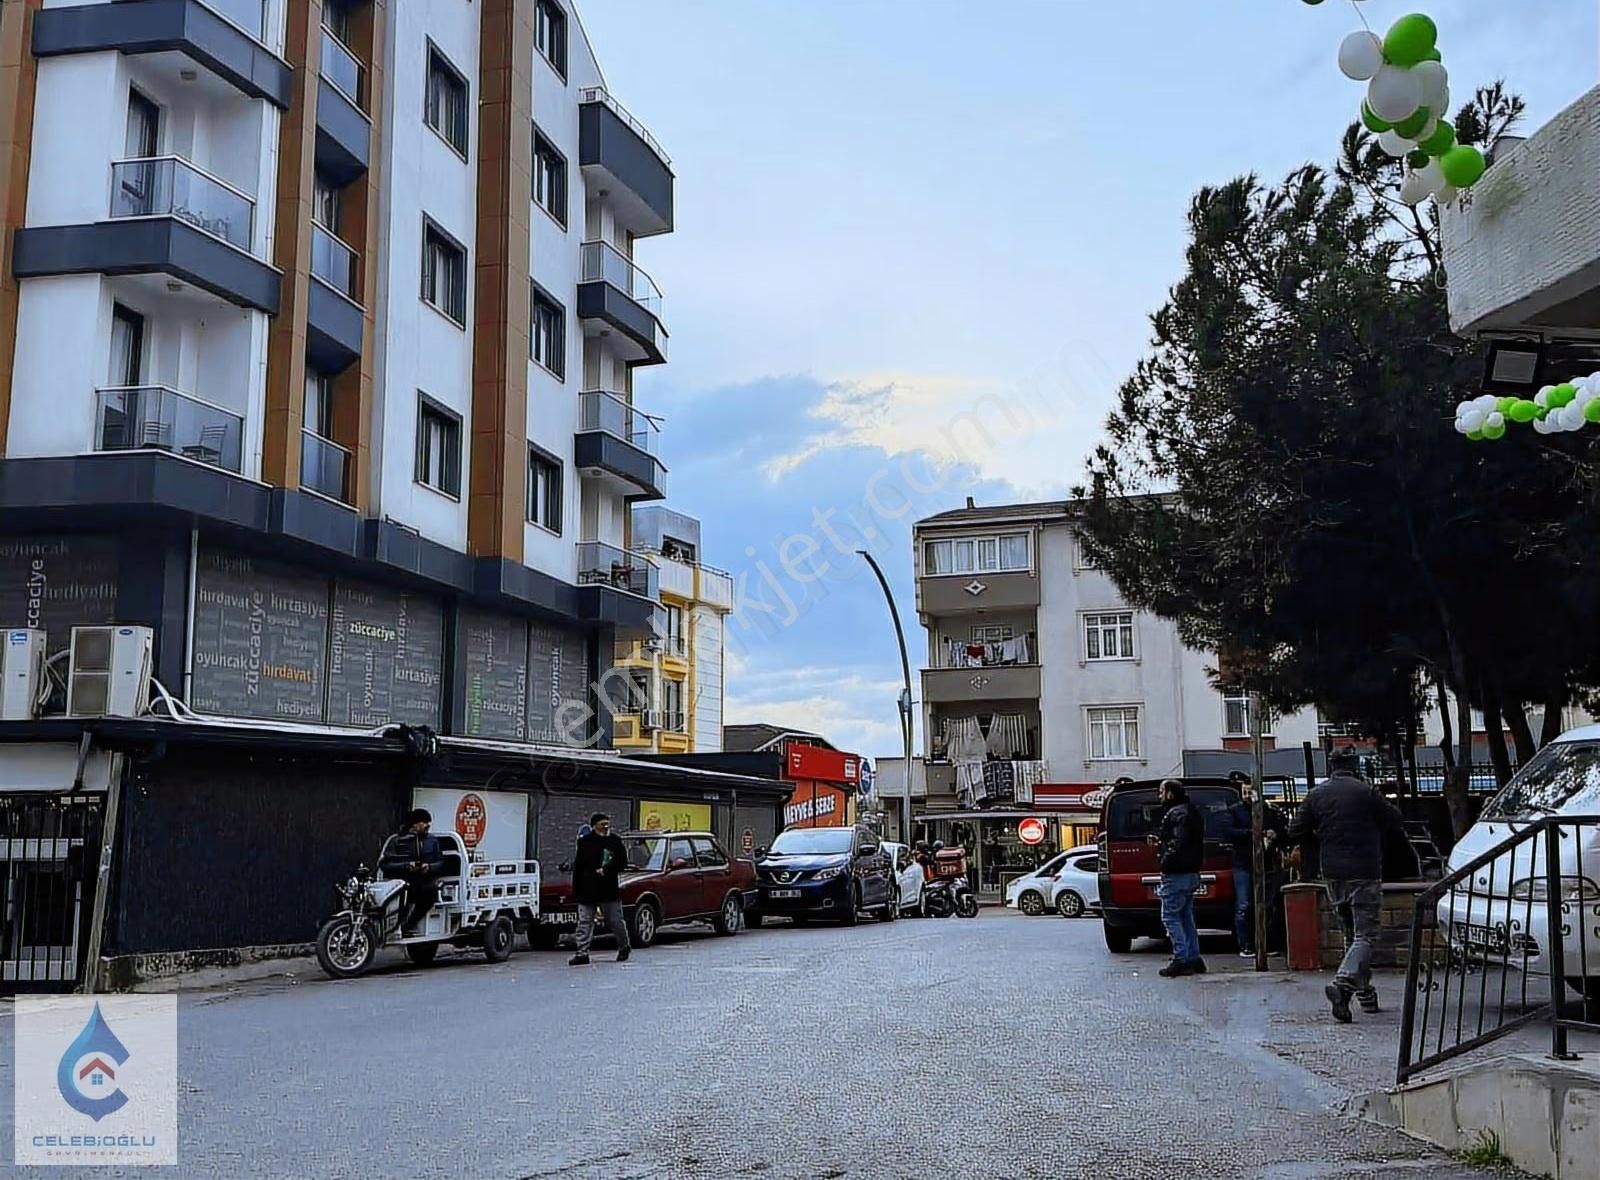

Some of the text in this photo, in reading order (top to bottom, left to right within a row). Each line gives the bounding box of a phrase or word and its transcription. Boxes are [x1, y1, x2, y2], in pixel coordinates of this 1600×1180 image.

[26, 559, 47, 628] ccaciye
[350, 621, 397, 642] züccaciye
[196, 652, 250, 671] oyuncak
[263, 661, 313, 685] hırdavat
